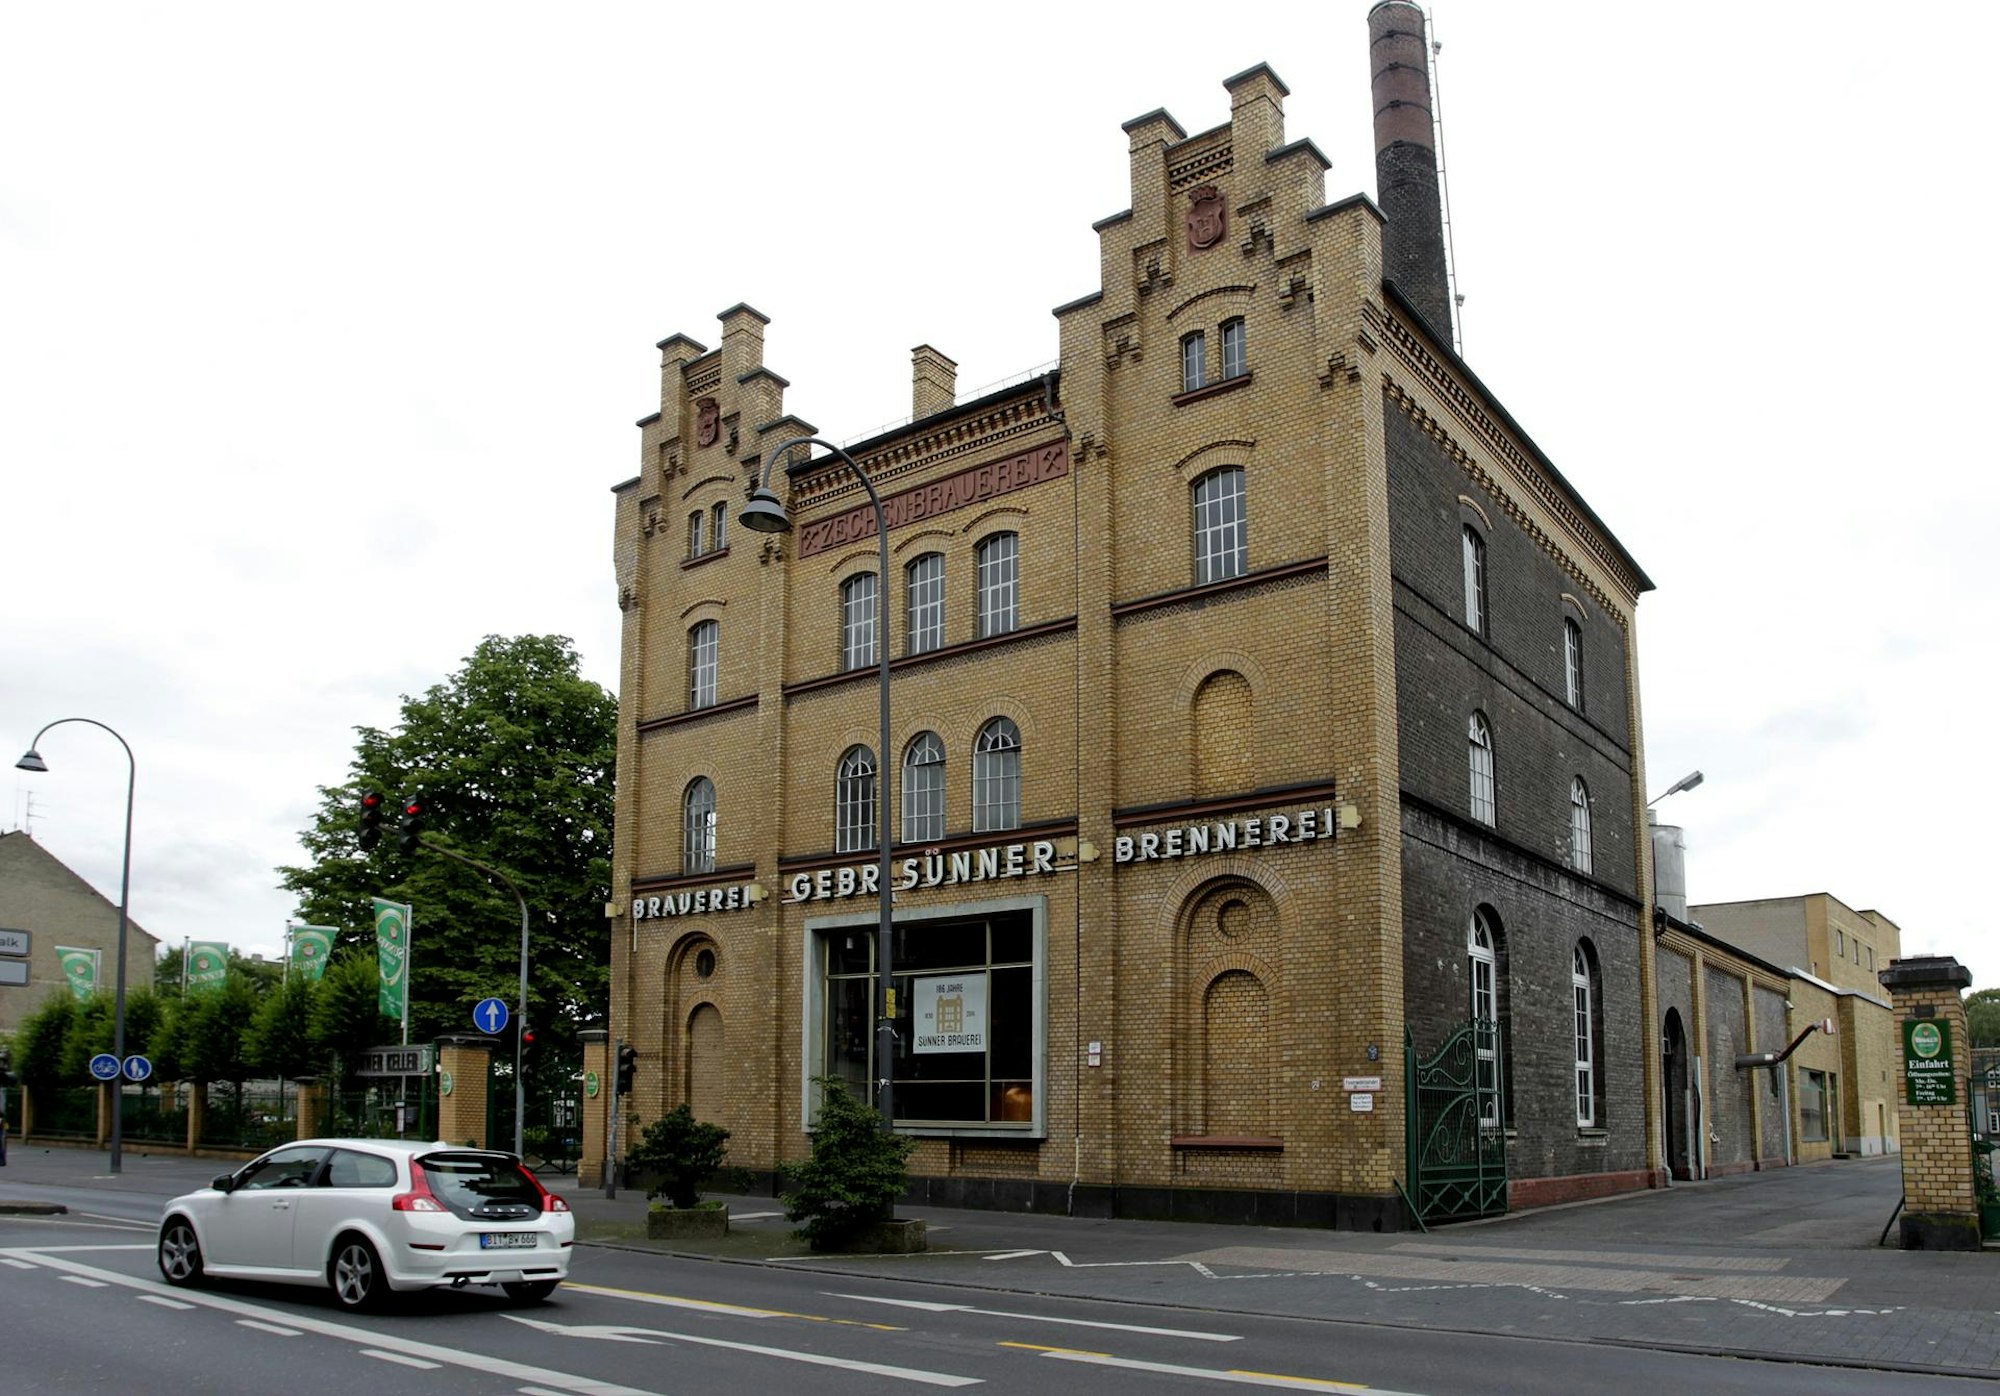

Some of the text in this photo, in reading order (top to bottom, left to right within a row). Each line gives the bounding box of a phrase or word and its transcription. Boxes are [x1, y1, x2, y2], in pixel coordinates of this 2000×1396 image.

[1115, 808, 1334, 863] BRENNEREI
[902, 841, 1055, 891] SÜNNER
[632, 885, 750, 919] BRAUEREI
[947, 983, 964, 993] JAHRE
[918, 1034, 981, 1047] SÜNNER BRAUEREI
[387, 1053, 418, 1072] KELLER
[1908, 1059, 1949, 1069] Einfahrt
[487, 1234, 503, 1245] BIT
[521, 1233, 536, 1244] 666
